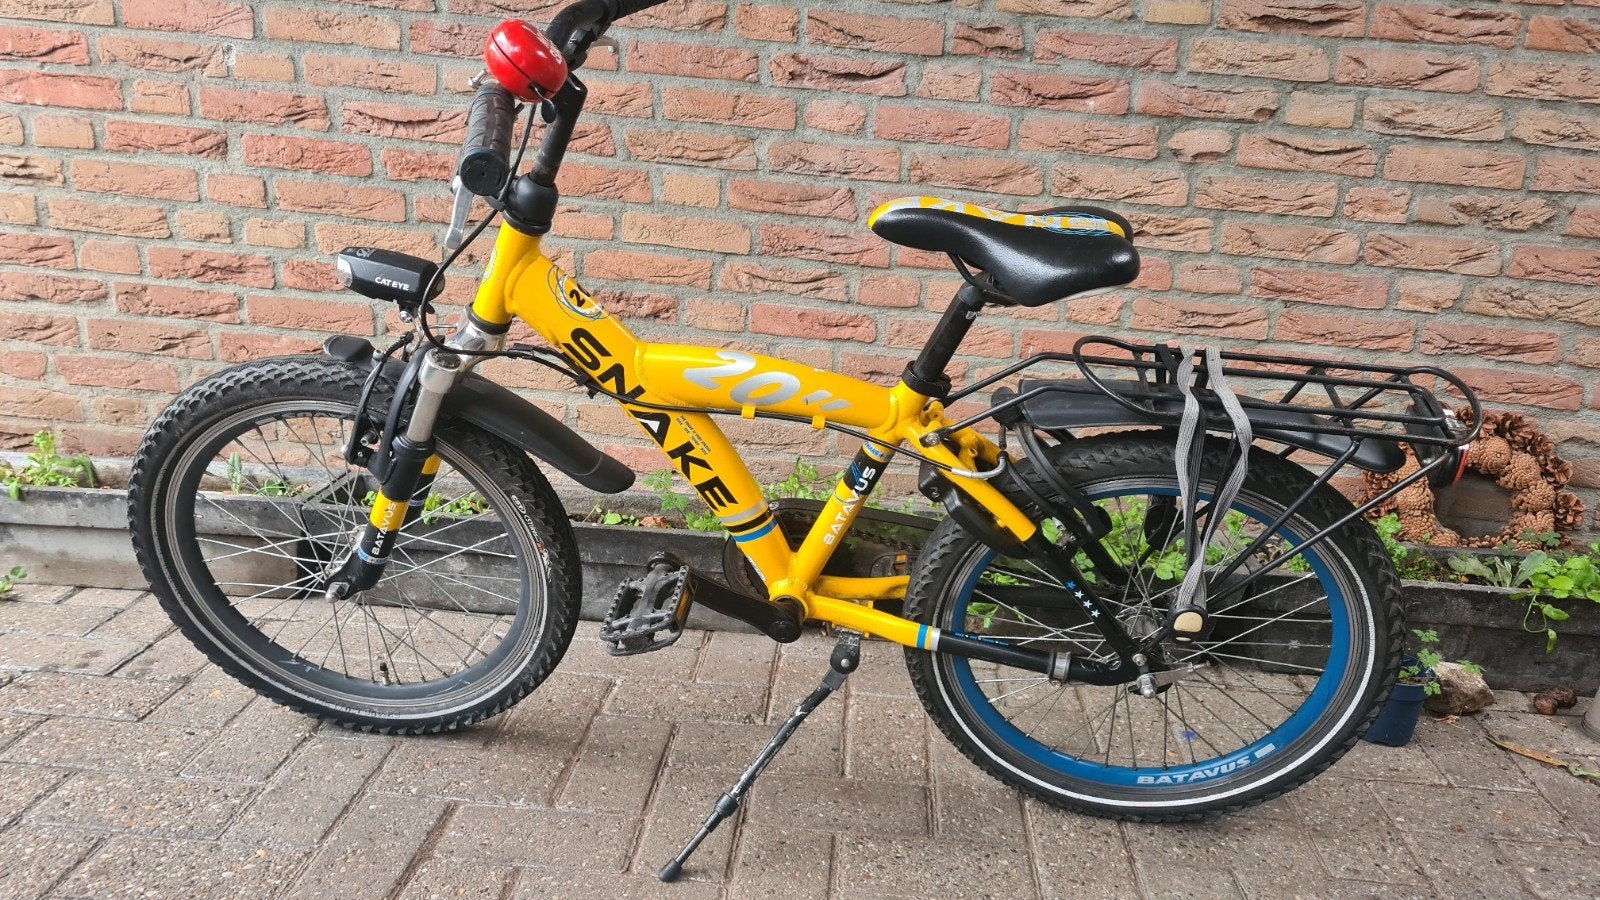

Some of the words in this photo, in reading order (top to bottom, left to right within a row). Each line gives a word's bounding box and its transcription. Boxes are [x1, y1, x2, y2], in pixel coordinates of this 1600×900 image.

[374, 276, 410, 291] CATEYE
[561, 327, 739, 512] SNAKE
[371, 502, 396, 556] BATAVUS
[822, 465, 876, 545] BATAVUS
[1136, 756, 1250, 785] BATAVUS
